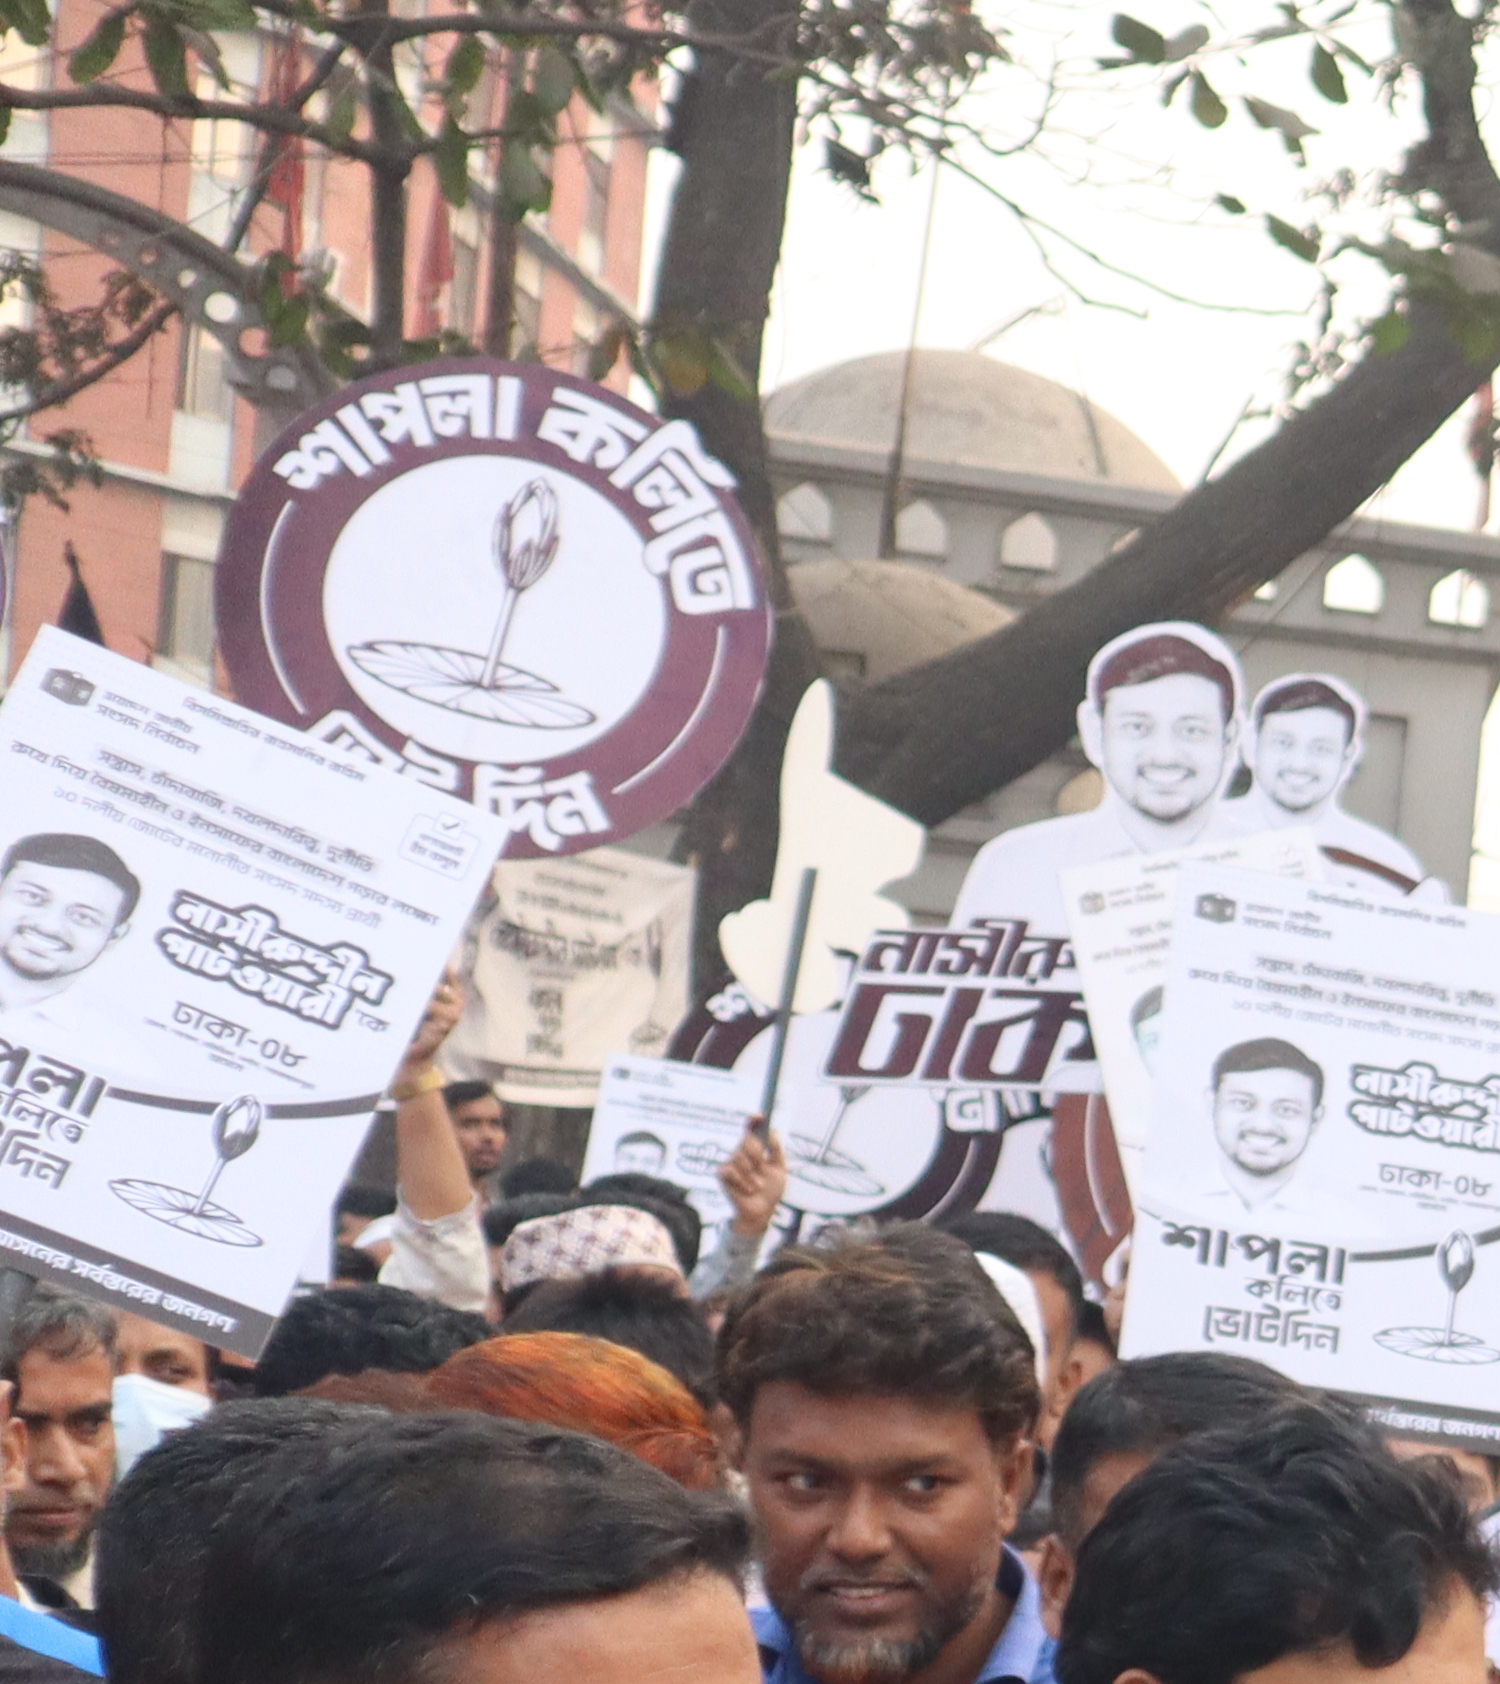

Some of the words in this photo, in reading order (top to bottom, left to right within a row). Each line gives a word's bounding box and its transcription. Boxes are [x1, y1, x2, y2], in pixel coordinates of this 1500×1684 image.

[273, 374, 524, 488] শাপলা
[537, 386, 756, 614] কলিতে
[95, 704, 141, 730] সংসদ
[143, 723, 200, 753] নির্বাচন
[156, 928, 350, 1030] পাটওয়ারী
[170, 890, 393, 1005] নাসীরুদ্দীন
[172, 1000, 307, 1068] ঢাকা-০৮
[825, 983, 1098, 1084] ঢাক
[0, 1037, 107, 1119] পলা
[0, 1087, 90, 1143] লিতে
[1378, 1162, 1493, 1198] ঢাকা-০৮
[1161, 1221, 1347, 1286] শাপলা
[161, 1293, 241, 1334] জনগণ
[1244, 1274, 1343, 1312] কলিতে
